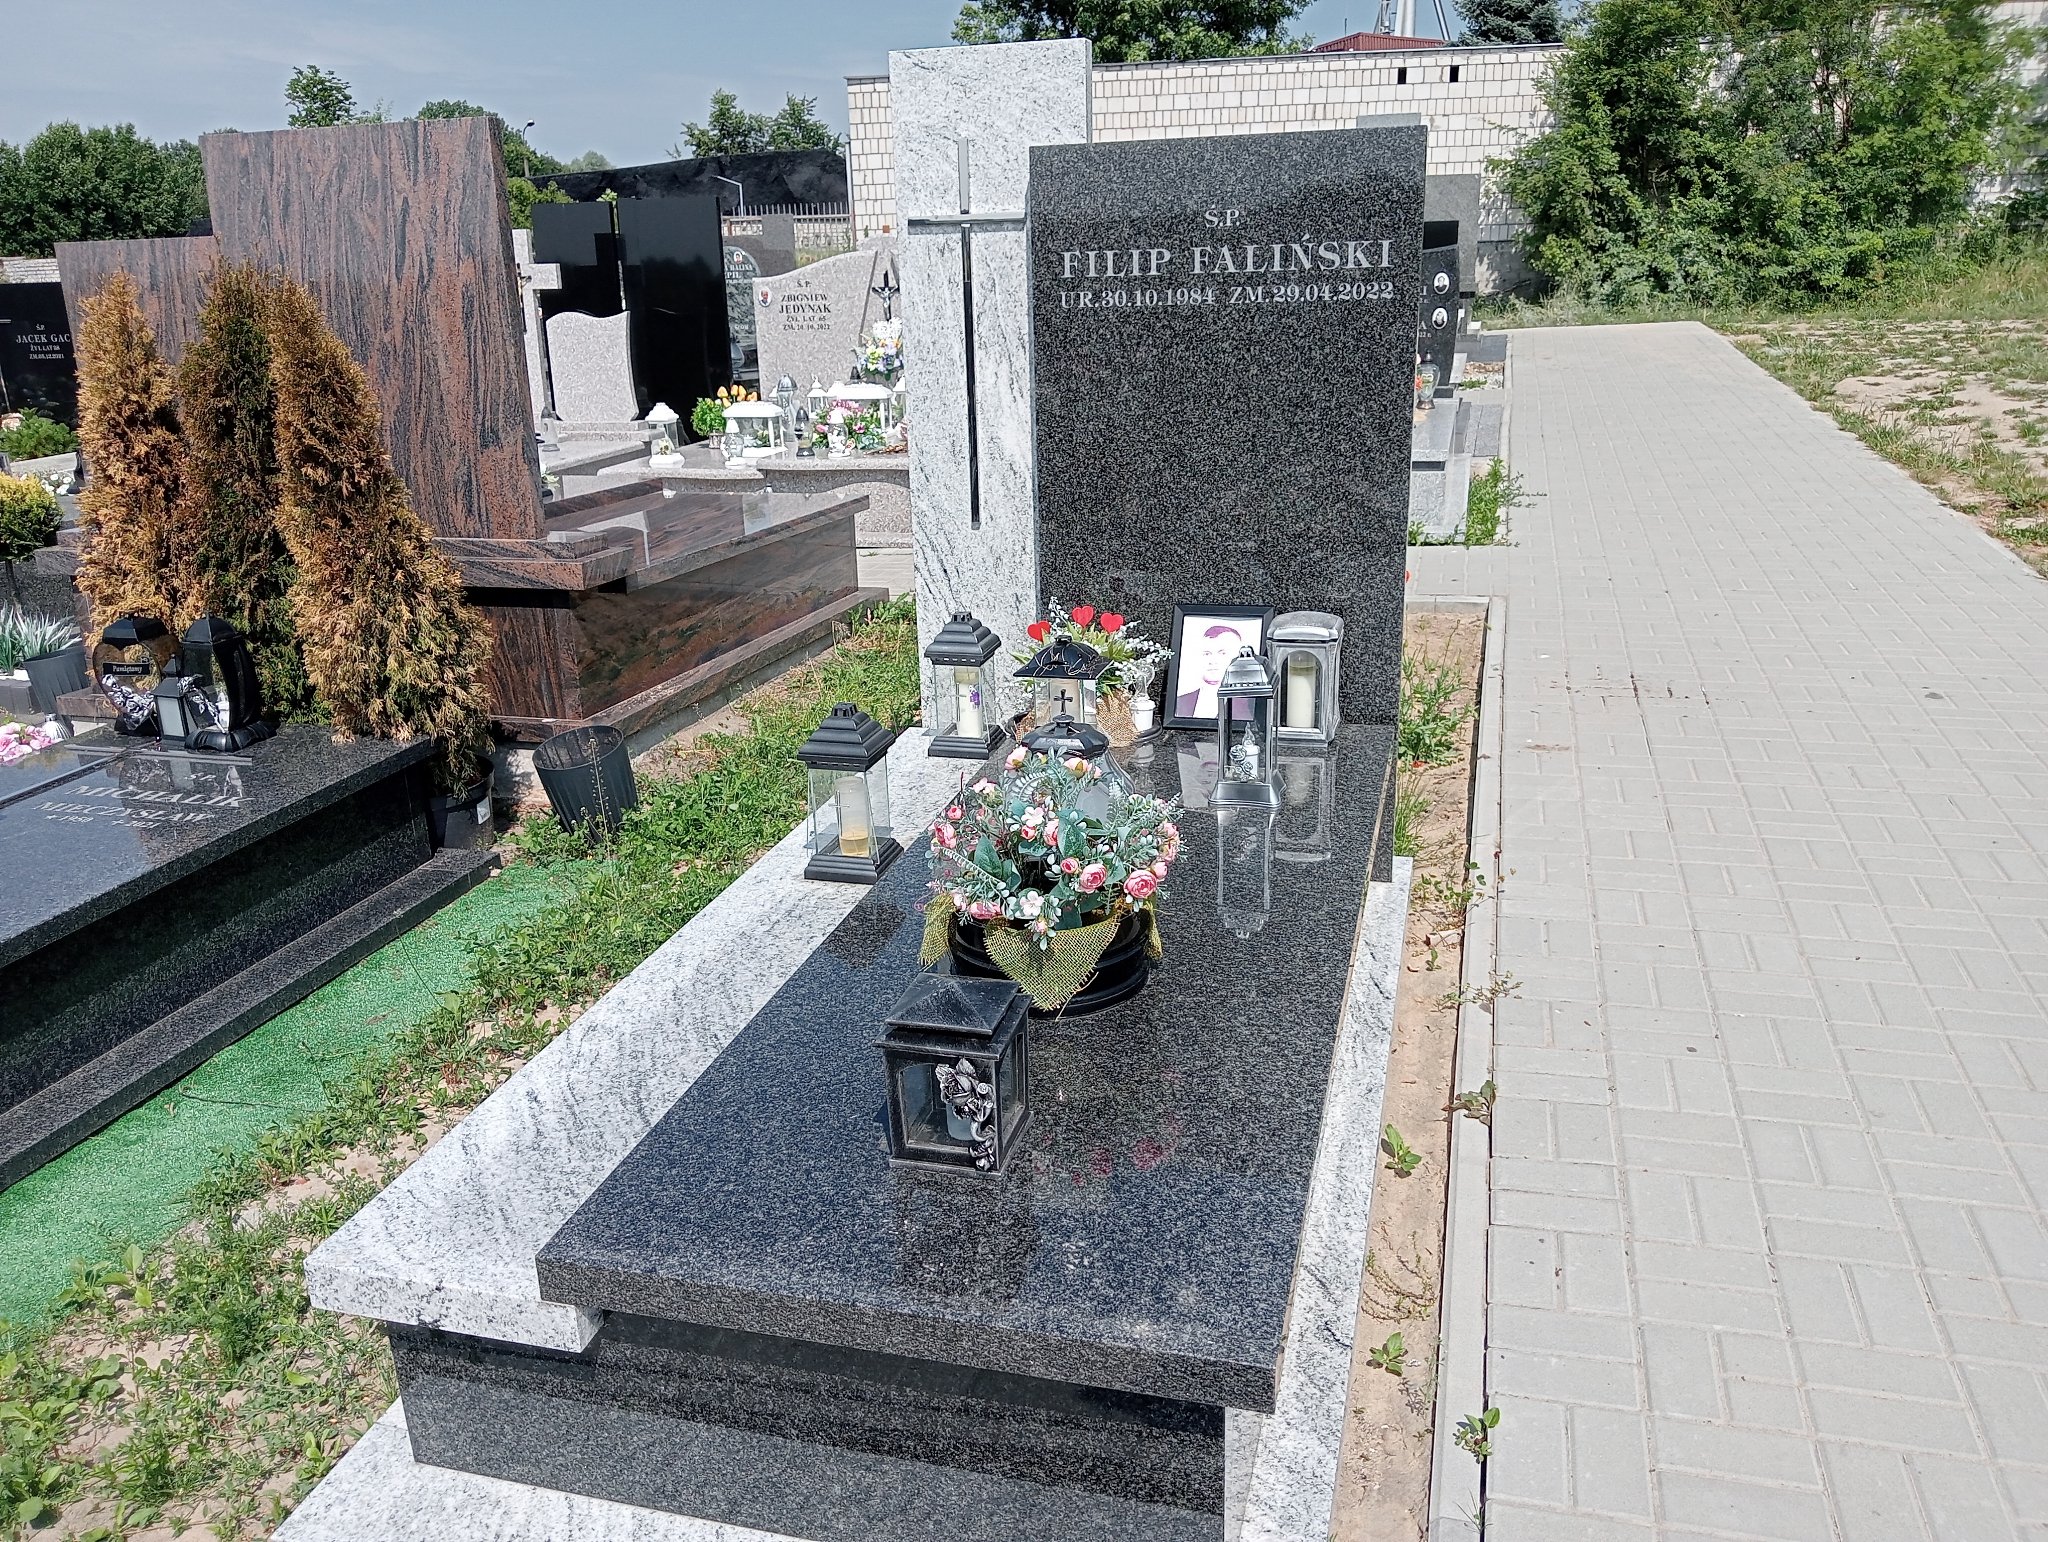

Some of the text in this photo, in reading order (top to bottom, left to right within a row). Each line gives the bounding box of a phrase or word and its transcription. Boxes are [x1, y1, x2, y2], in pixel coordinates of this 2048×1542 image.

[1204, 203, 1240, 228] Ś.P.
[1060, 233, 1396, 280] FILIP FALIŃSKI
[781, 293, 828, 302] ZBIGNIEW
[1060, 287, 1217, 309] UR.30.10.1984
[1228, 281, 1394, 304] ZM.29.04.2022
[16, 334, 70, 343] JACEK GAC
[65, 785, 256, 808] MICHALIK
